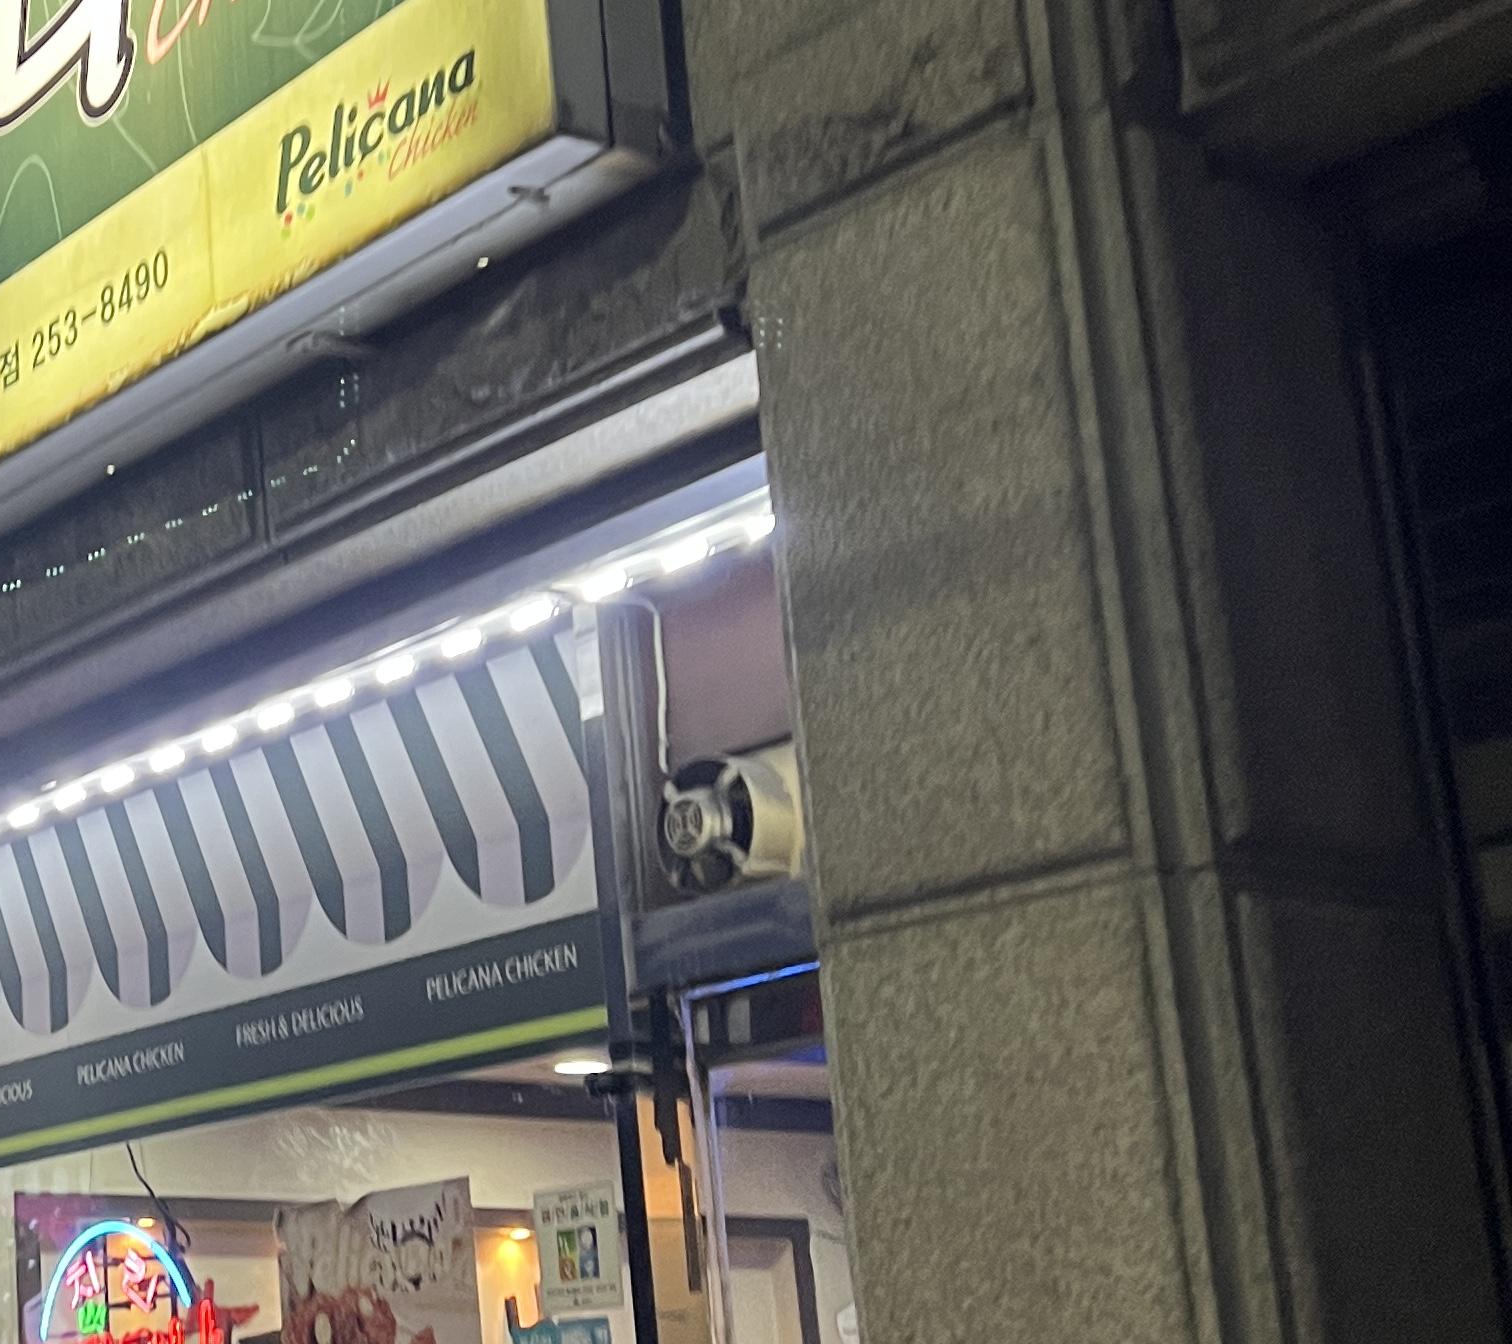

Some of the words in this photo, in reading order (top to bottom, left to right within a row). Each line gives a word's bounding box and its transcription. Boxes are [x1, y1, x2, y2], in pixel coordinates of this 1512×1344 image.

[275, 50, 477, 215] Pelicana
[31, 250, 170, 371] 253-8490
[426, 963, 504, 1002] PELICANA
[505, 942, 578, 986] CHICKEN
[236, 1019, 279, 1049] FRESH
[291, 995, 365, 1037] DELICIOUS
[77, 1056, 133, 1086] PELICANA
[132, 1041, 185, 1074] CHICKEN
